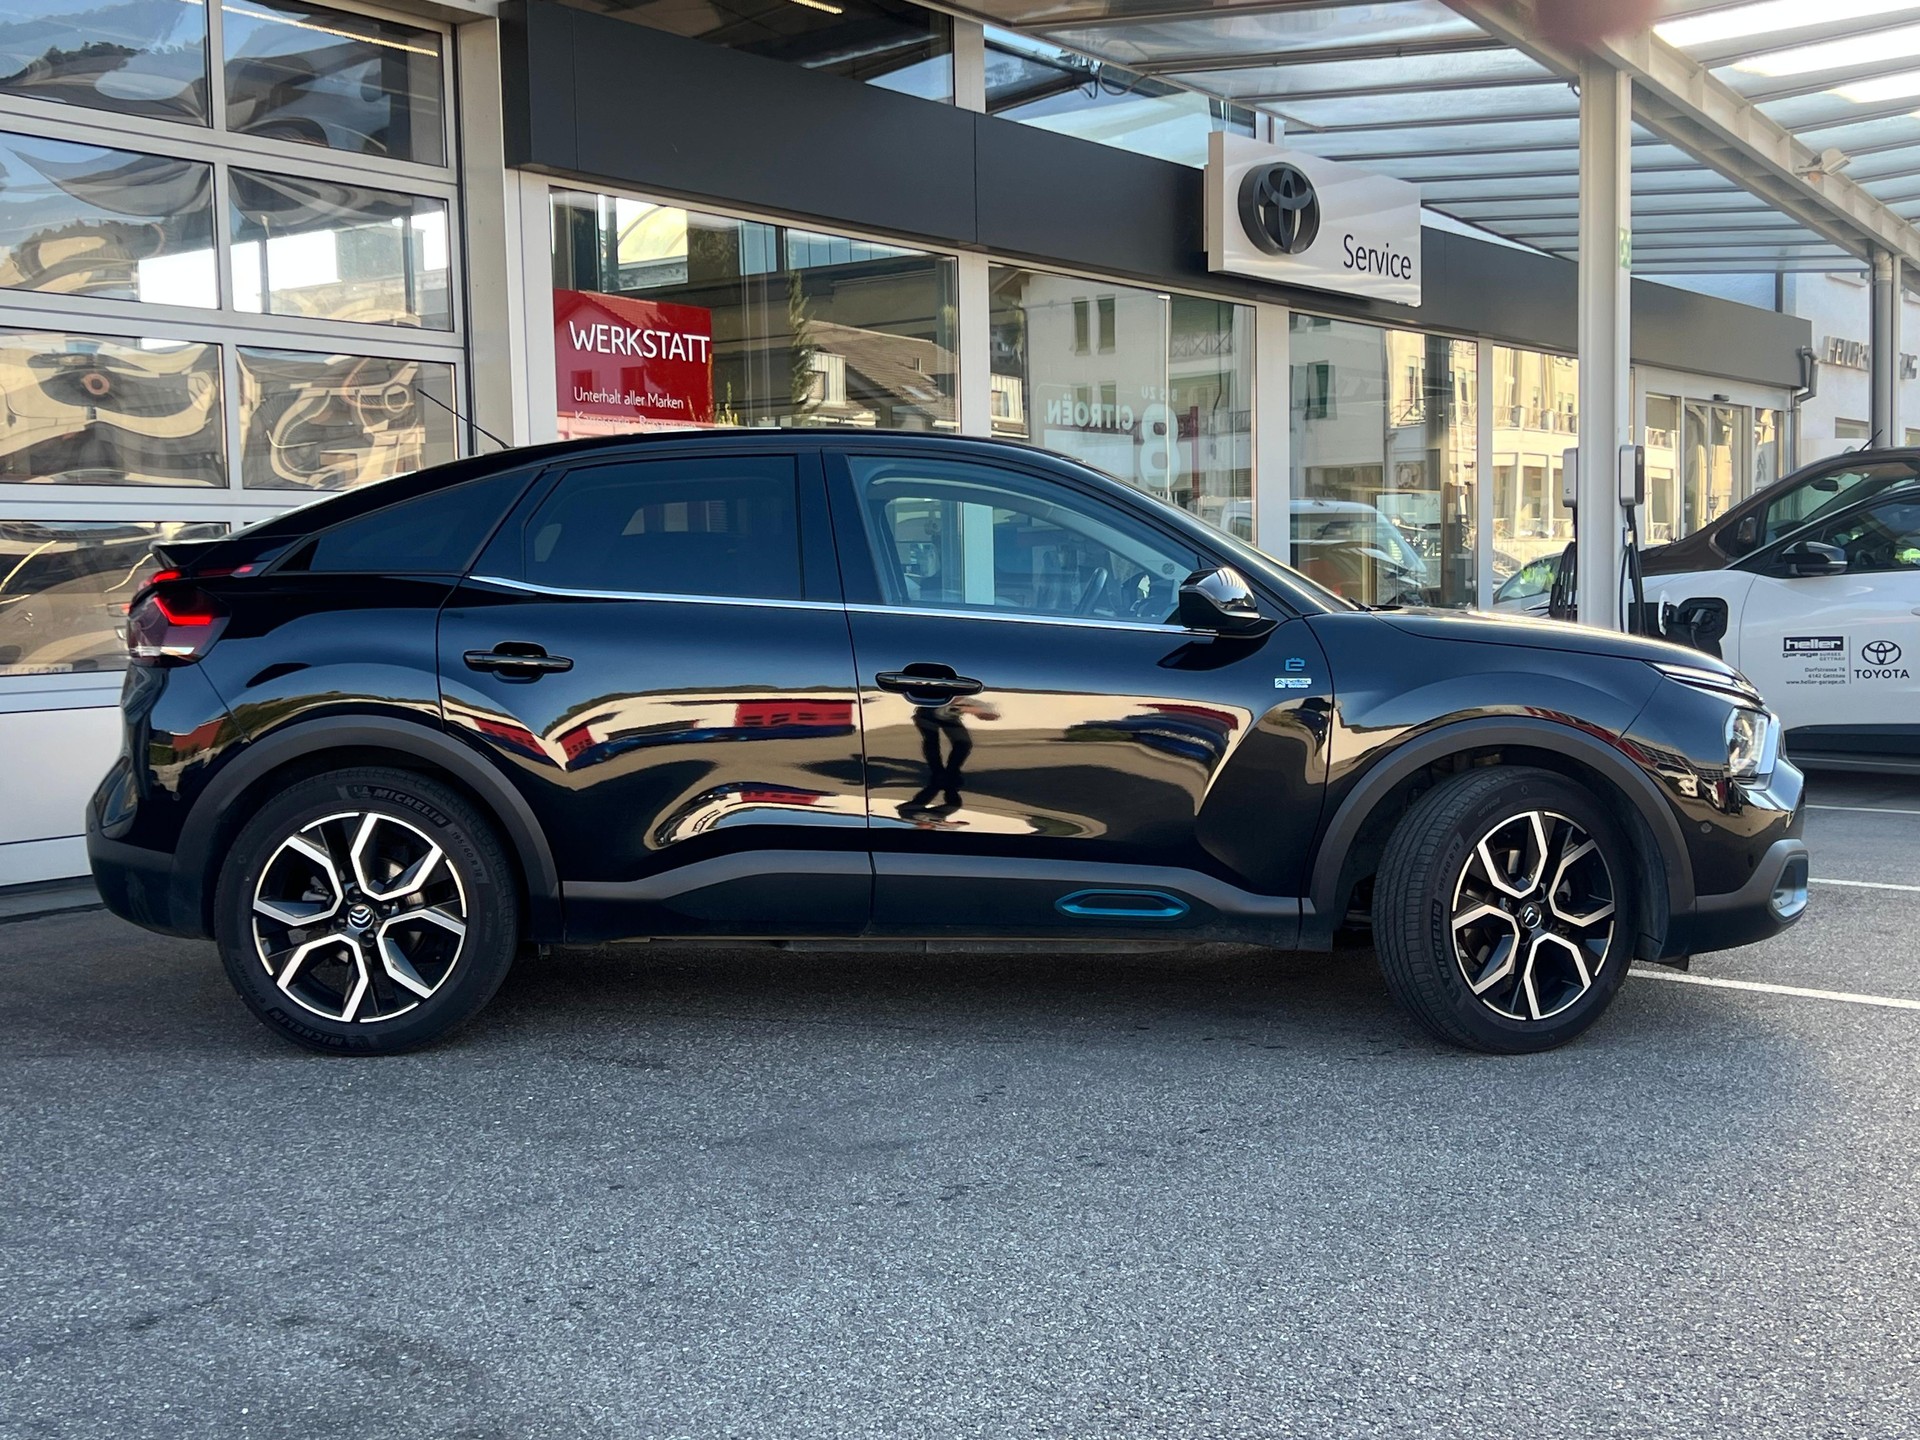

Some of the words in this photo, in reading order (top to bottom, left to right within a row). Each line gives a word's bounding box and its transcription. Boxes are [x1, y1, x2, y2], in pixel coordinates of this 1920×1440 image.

[1343, 234, 1411, 280] Service
[569, 321, 710, 363] WERKSTATT
[574, 387, 621, 404] Unterhalt
[624, 390, 645, 406] aller
[647, 393, 684, 409] Marken
[1785, 639, 1841, 649] heller
[1853, 668, 1910, 680] TOYOTA
[374, 788, 447, 826] MICHELIN
[1433, 903, 1450, 980] MICHELIN
[270, 1009, 346, 1045] MICHELIN
